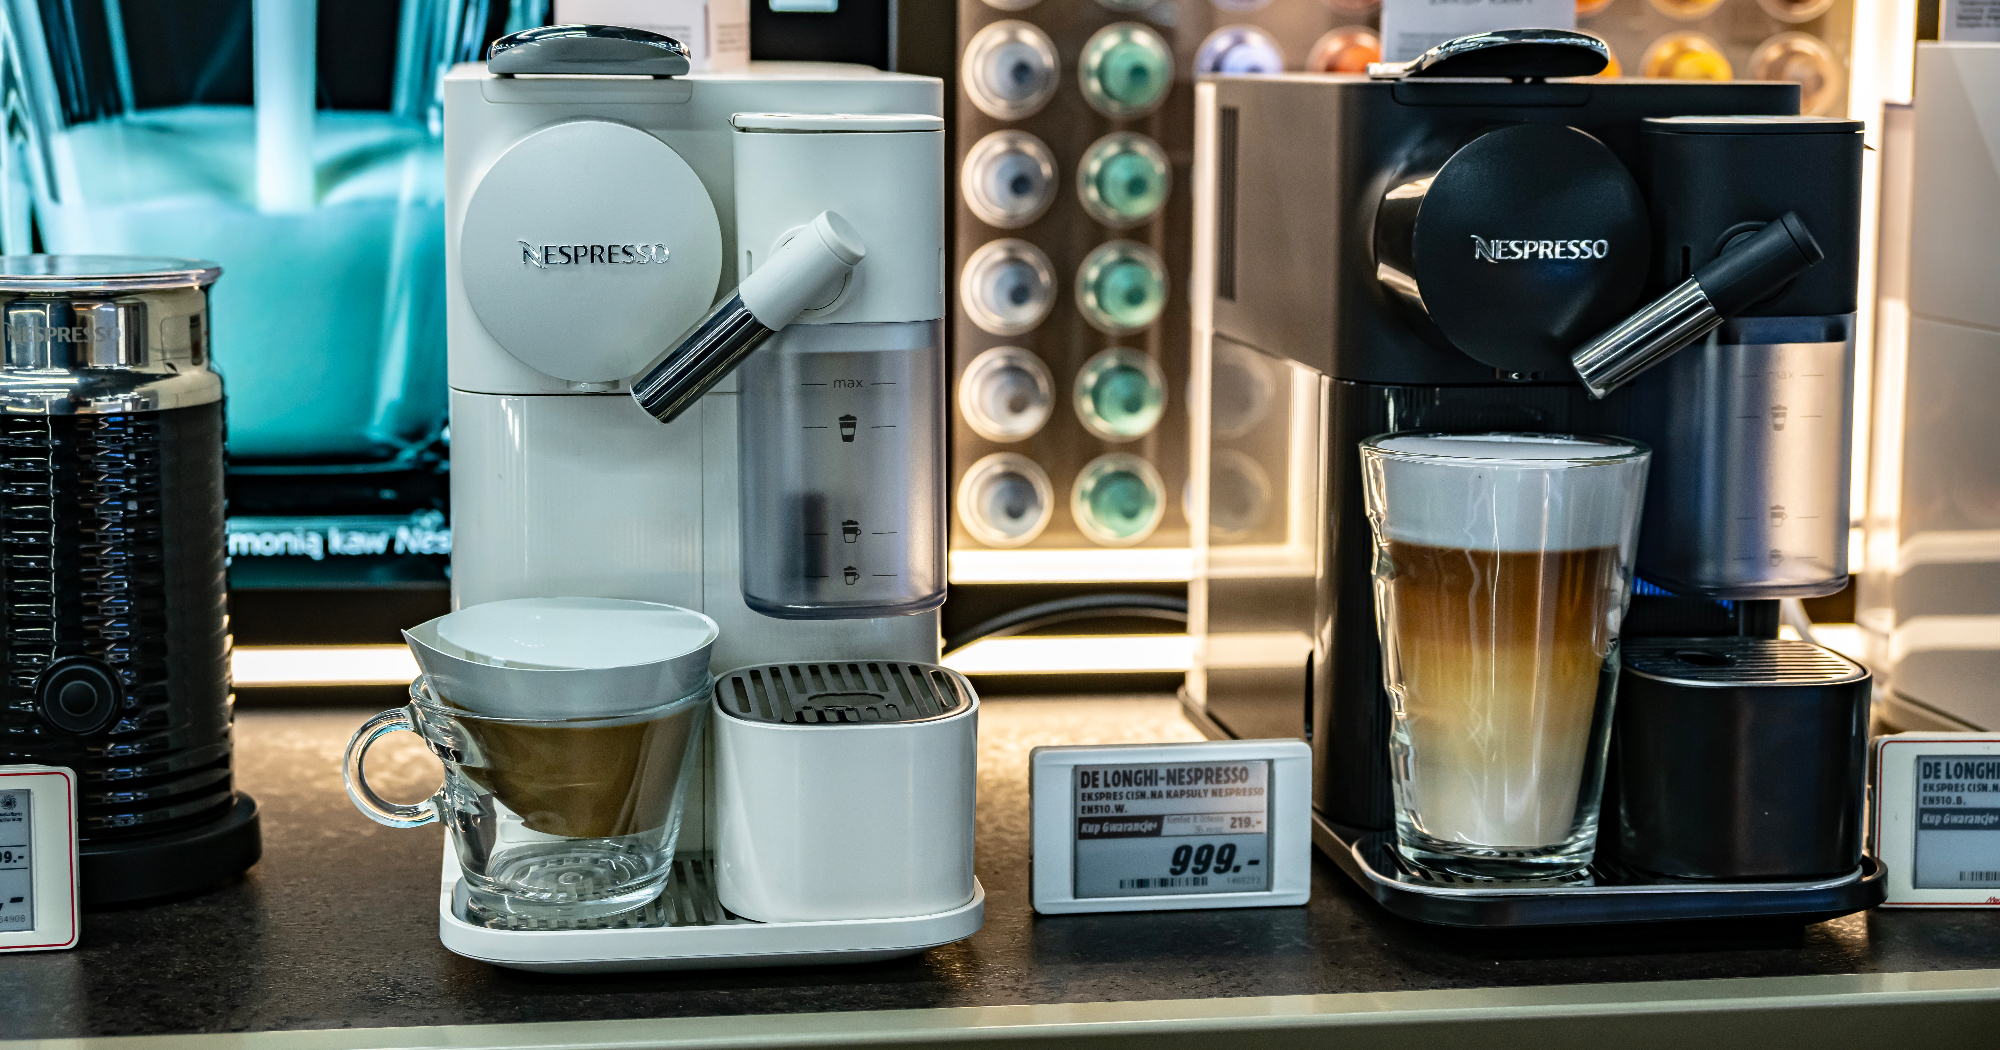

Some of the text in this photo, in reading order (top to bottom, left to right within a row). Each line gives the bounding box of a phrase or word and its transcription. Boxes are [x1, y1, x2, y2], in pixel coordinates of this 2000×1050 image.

[518, 240, 670, 269] NESPRESSO
[1470, 234, 1610, 264] NESPRESSO
[4, 322, 121, 343] NESPRESSO
[833, 379, 864, 389] max
[327, 526, 390, 555] kaw
[1080, 766, 1250, 789] DE LONGHI-NESPRESSO
[1922, 762, 1942, 779] DE
[1081, 791, 1124, 802] EKSPRES
[1211, 786, 1265, 798] NESPRESSO
[1922, 782, 2000, 792] EKSPRES CISN.N
[1922, 795, 1966, 806] EN510.B.
[1081, 803, 1128, 815] EN510.W.
[1229, 815, 1262, 829] 219.-
[1922, 813, 1942, 826] Kup
[1081, 822, 1100, 835] Kup
[1169, 843, 1260, 876] 999.-
